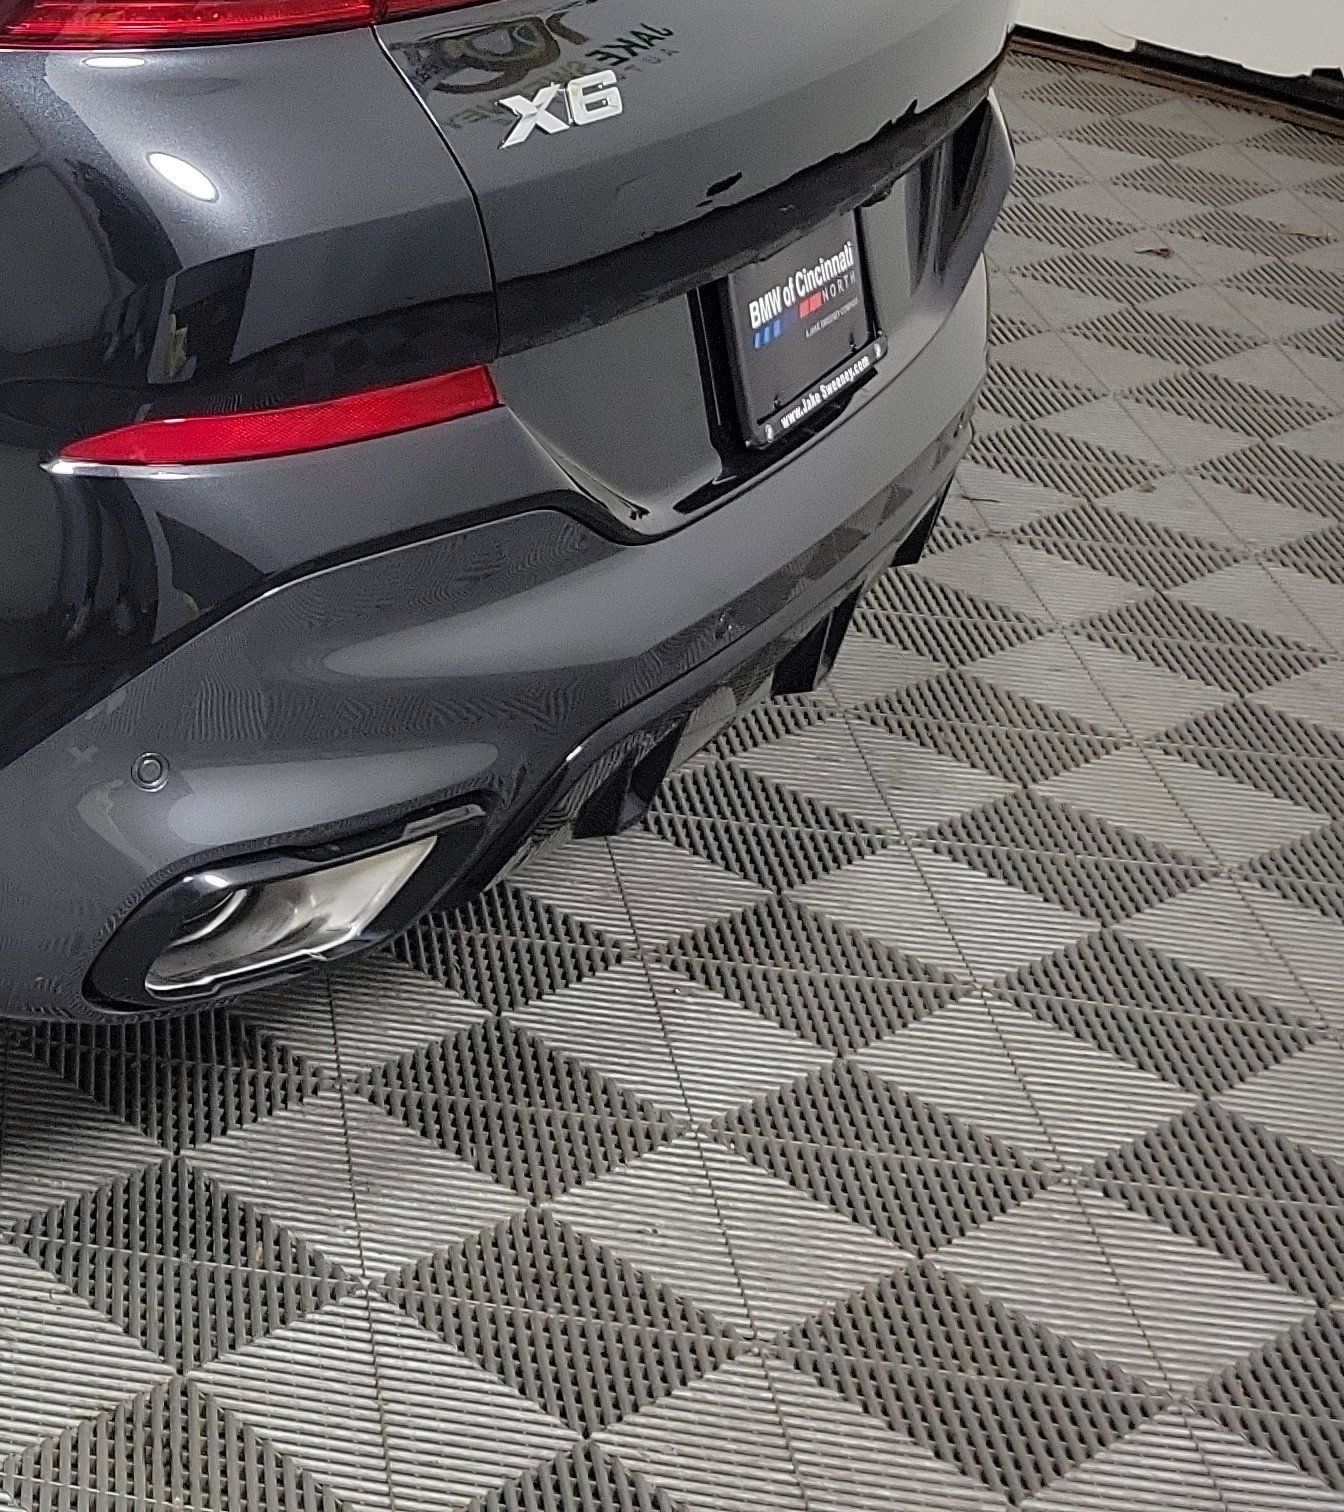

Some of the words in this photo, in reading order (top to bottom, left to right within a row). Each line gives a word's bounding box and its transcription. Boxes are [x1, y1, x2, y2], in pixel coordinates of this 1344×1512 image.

[496, 69, 623, 150] X6
[749, 285, 782, 329] BMW
[782, 276, 796, 308] of
[795, 240, 854, 297] Cincinnati
[822, 269, 856, 304] NORTH
[780, 392, 822, 429] www.Jake
[819, 355, 870, 400] Sweeney.com
